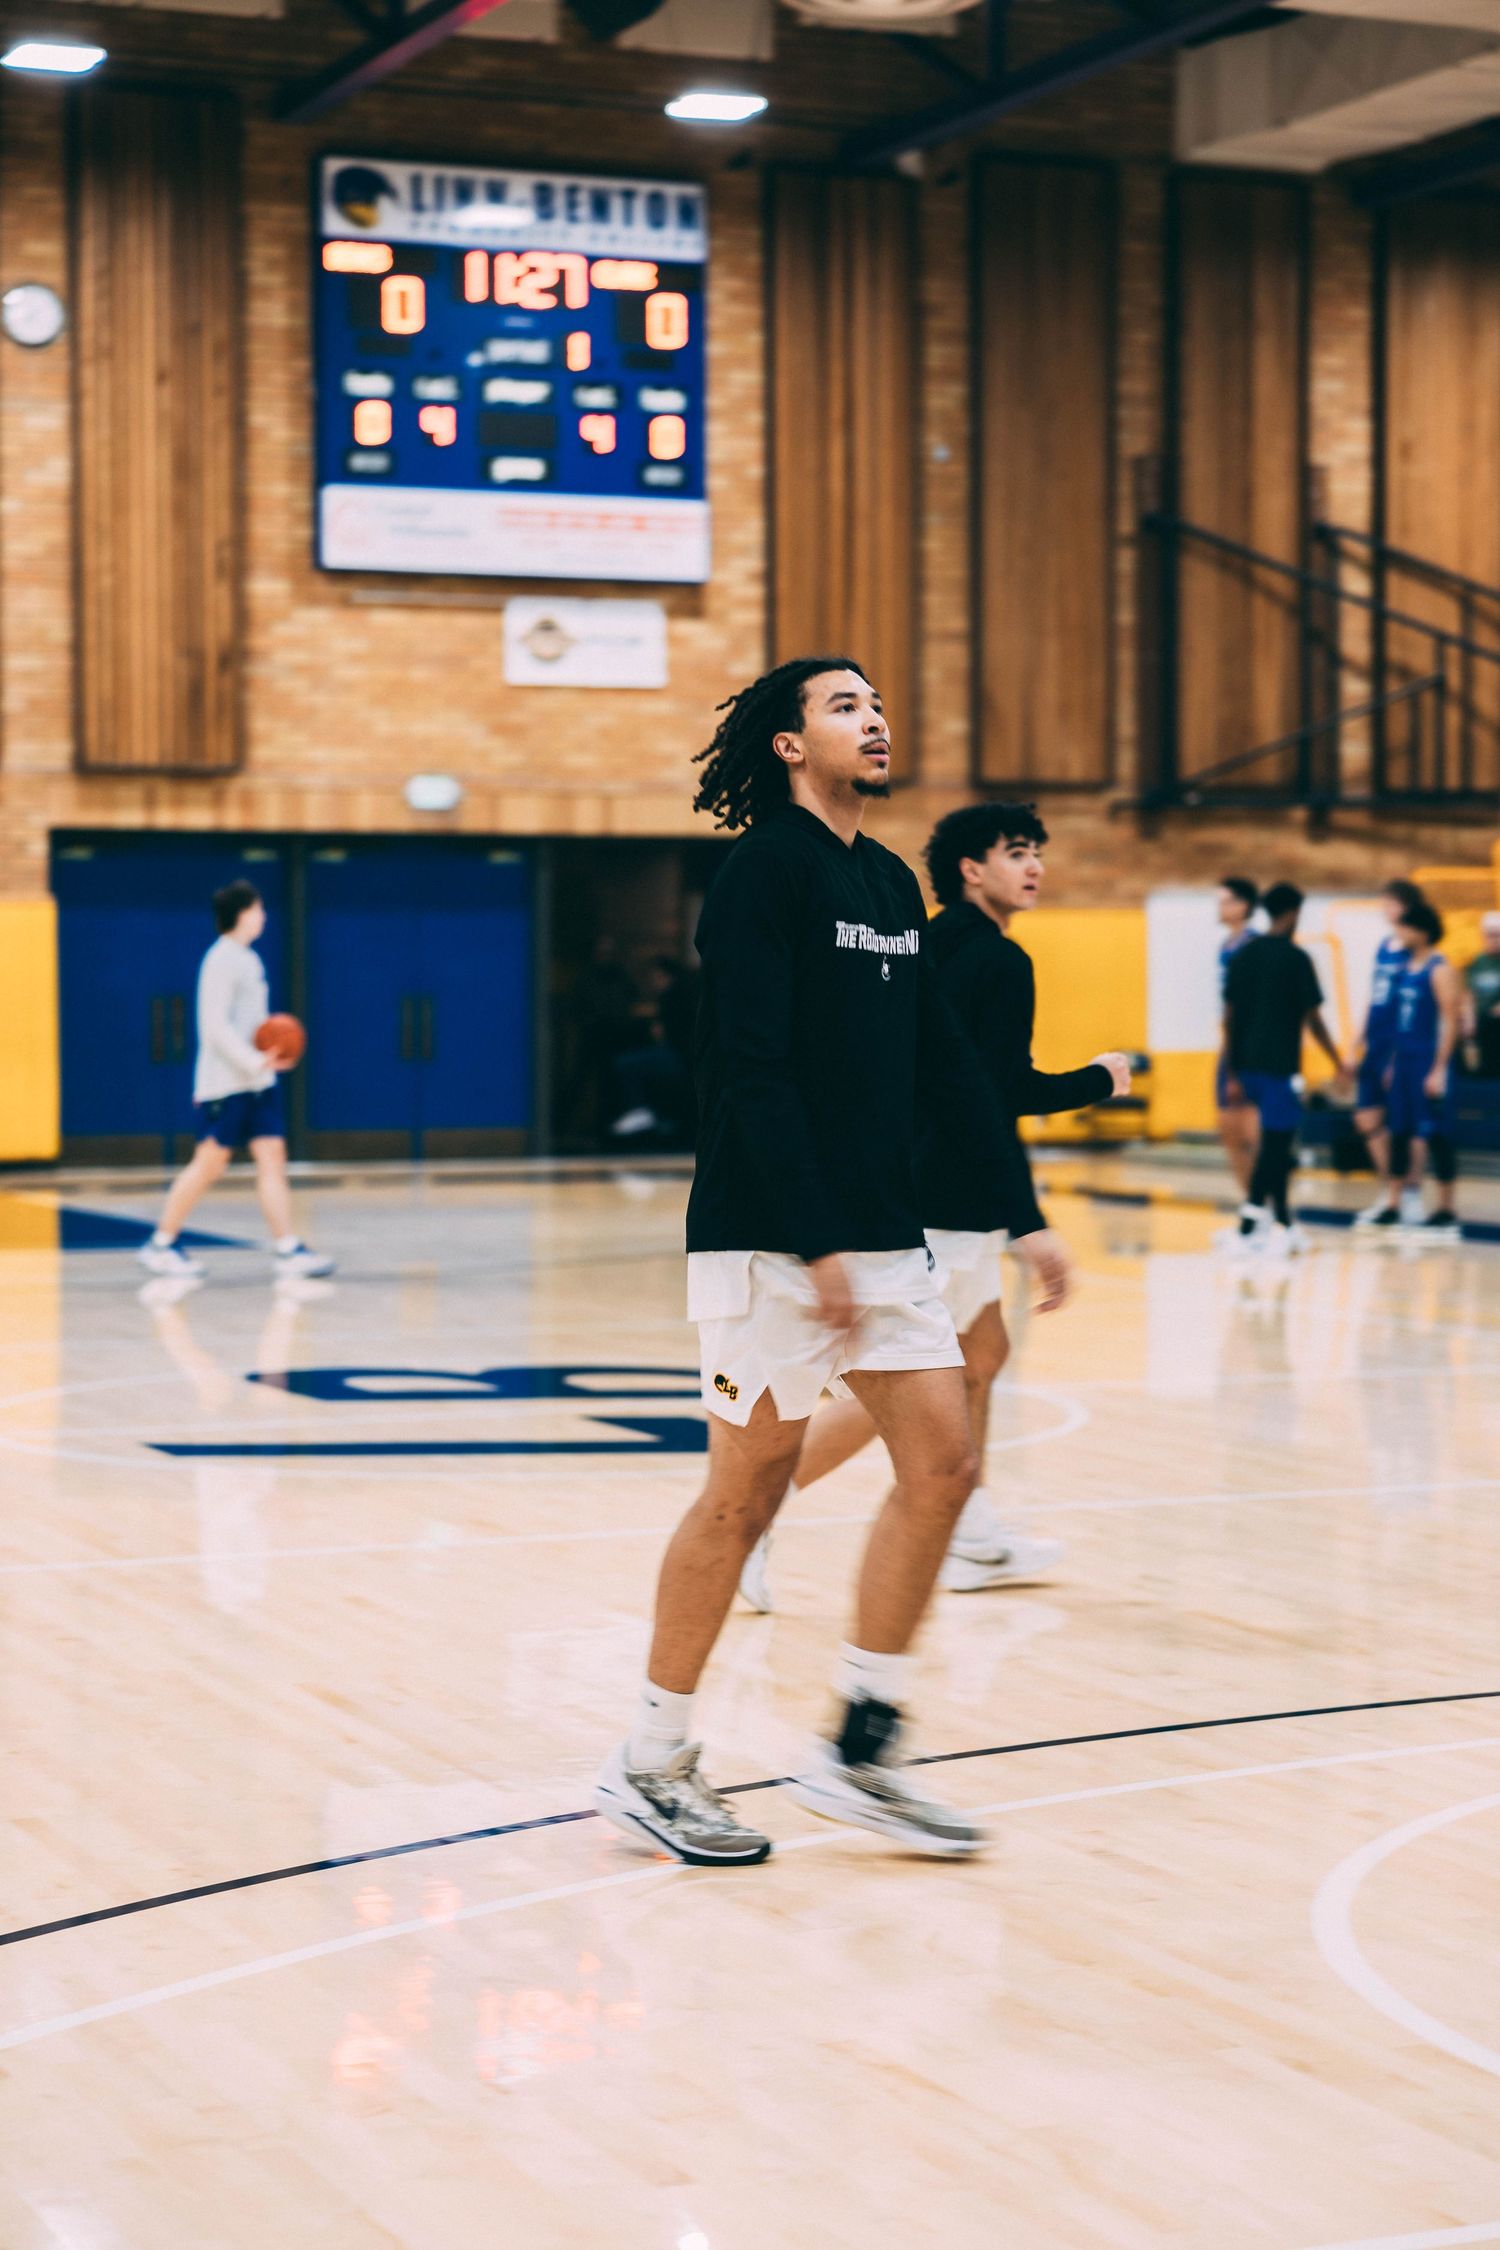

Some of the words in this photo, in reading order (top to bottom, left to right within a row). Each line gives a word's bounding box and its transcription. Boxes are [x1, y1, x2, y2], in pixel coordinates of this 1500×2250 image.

[381, 275, 425, 334] 0
[645, 292, 688, 350] 0
[567, 331, 591, 371] 1
